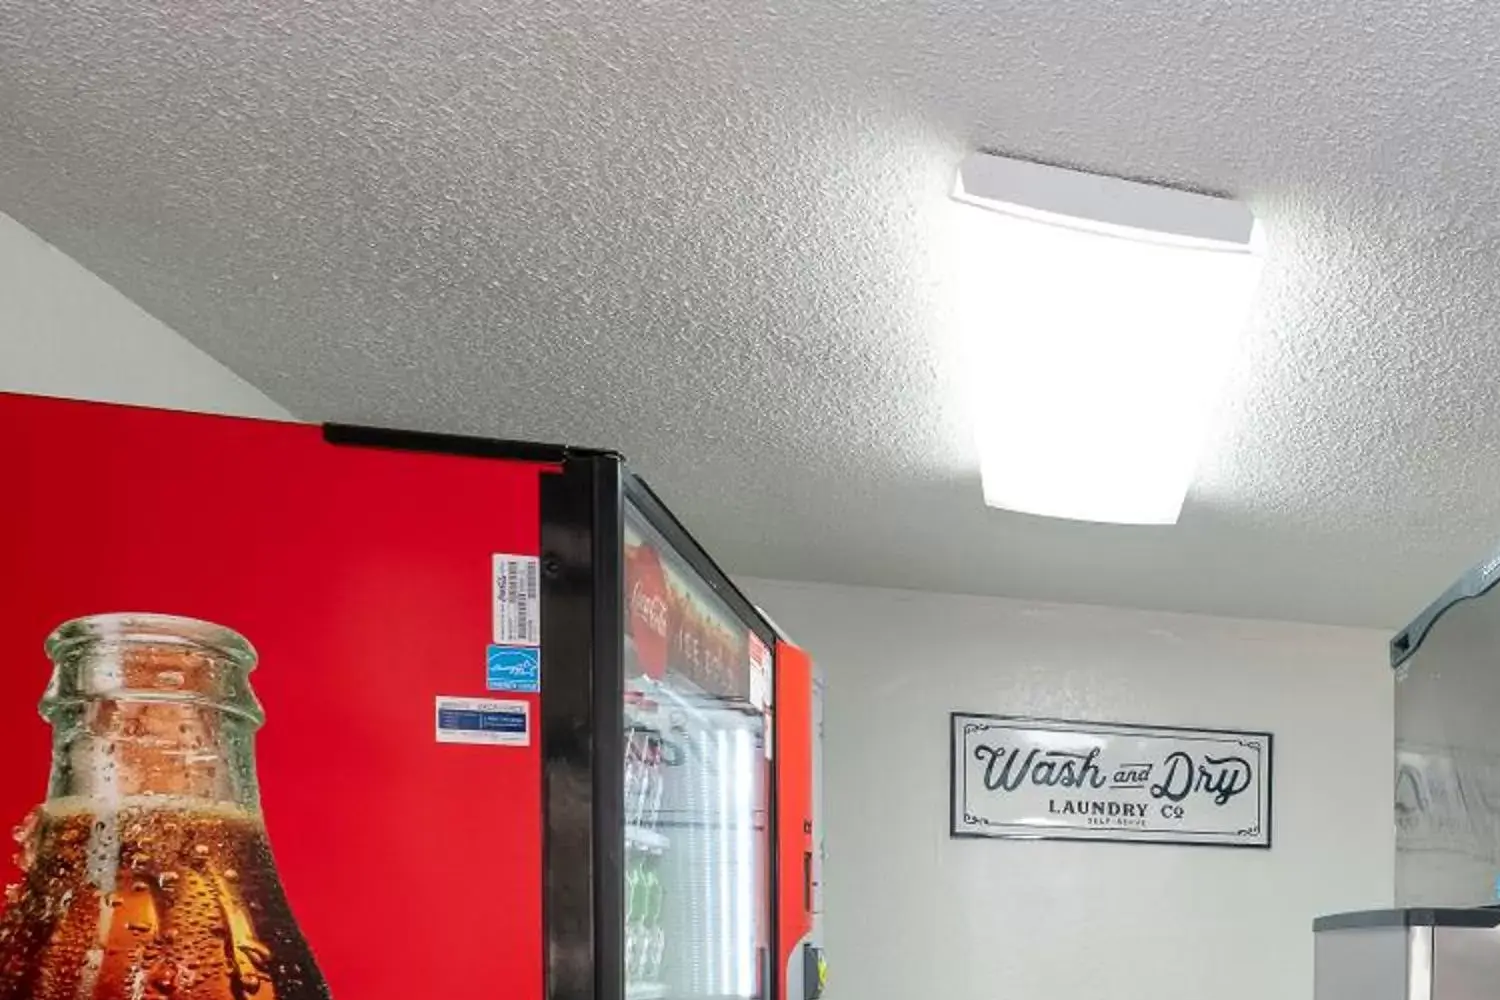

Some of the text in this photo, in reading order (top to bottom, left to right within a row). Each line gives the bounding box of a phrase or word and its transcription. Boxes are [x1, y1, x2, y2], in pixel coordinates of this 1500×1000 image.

[974, 744, 1251, 805] Wash and Dry
[1049, 799, 1148, 817] LAUNDRY
